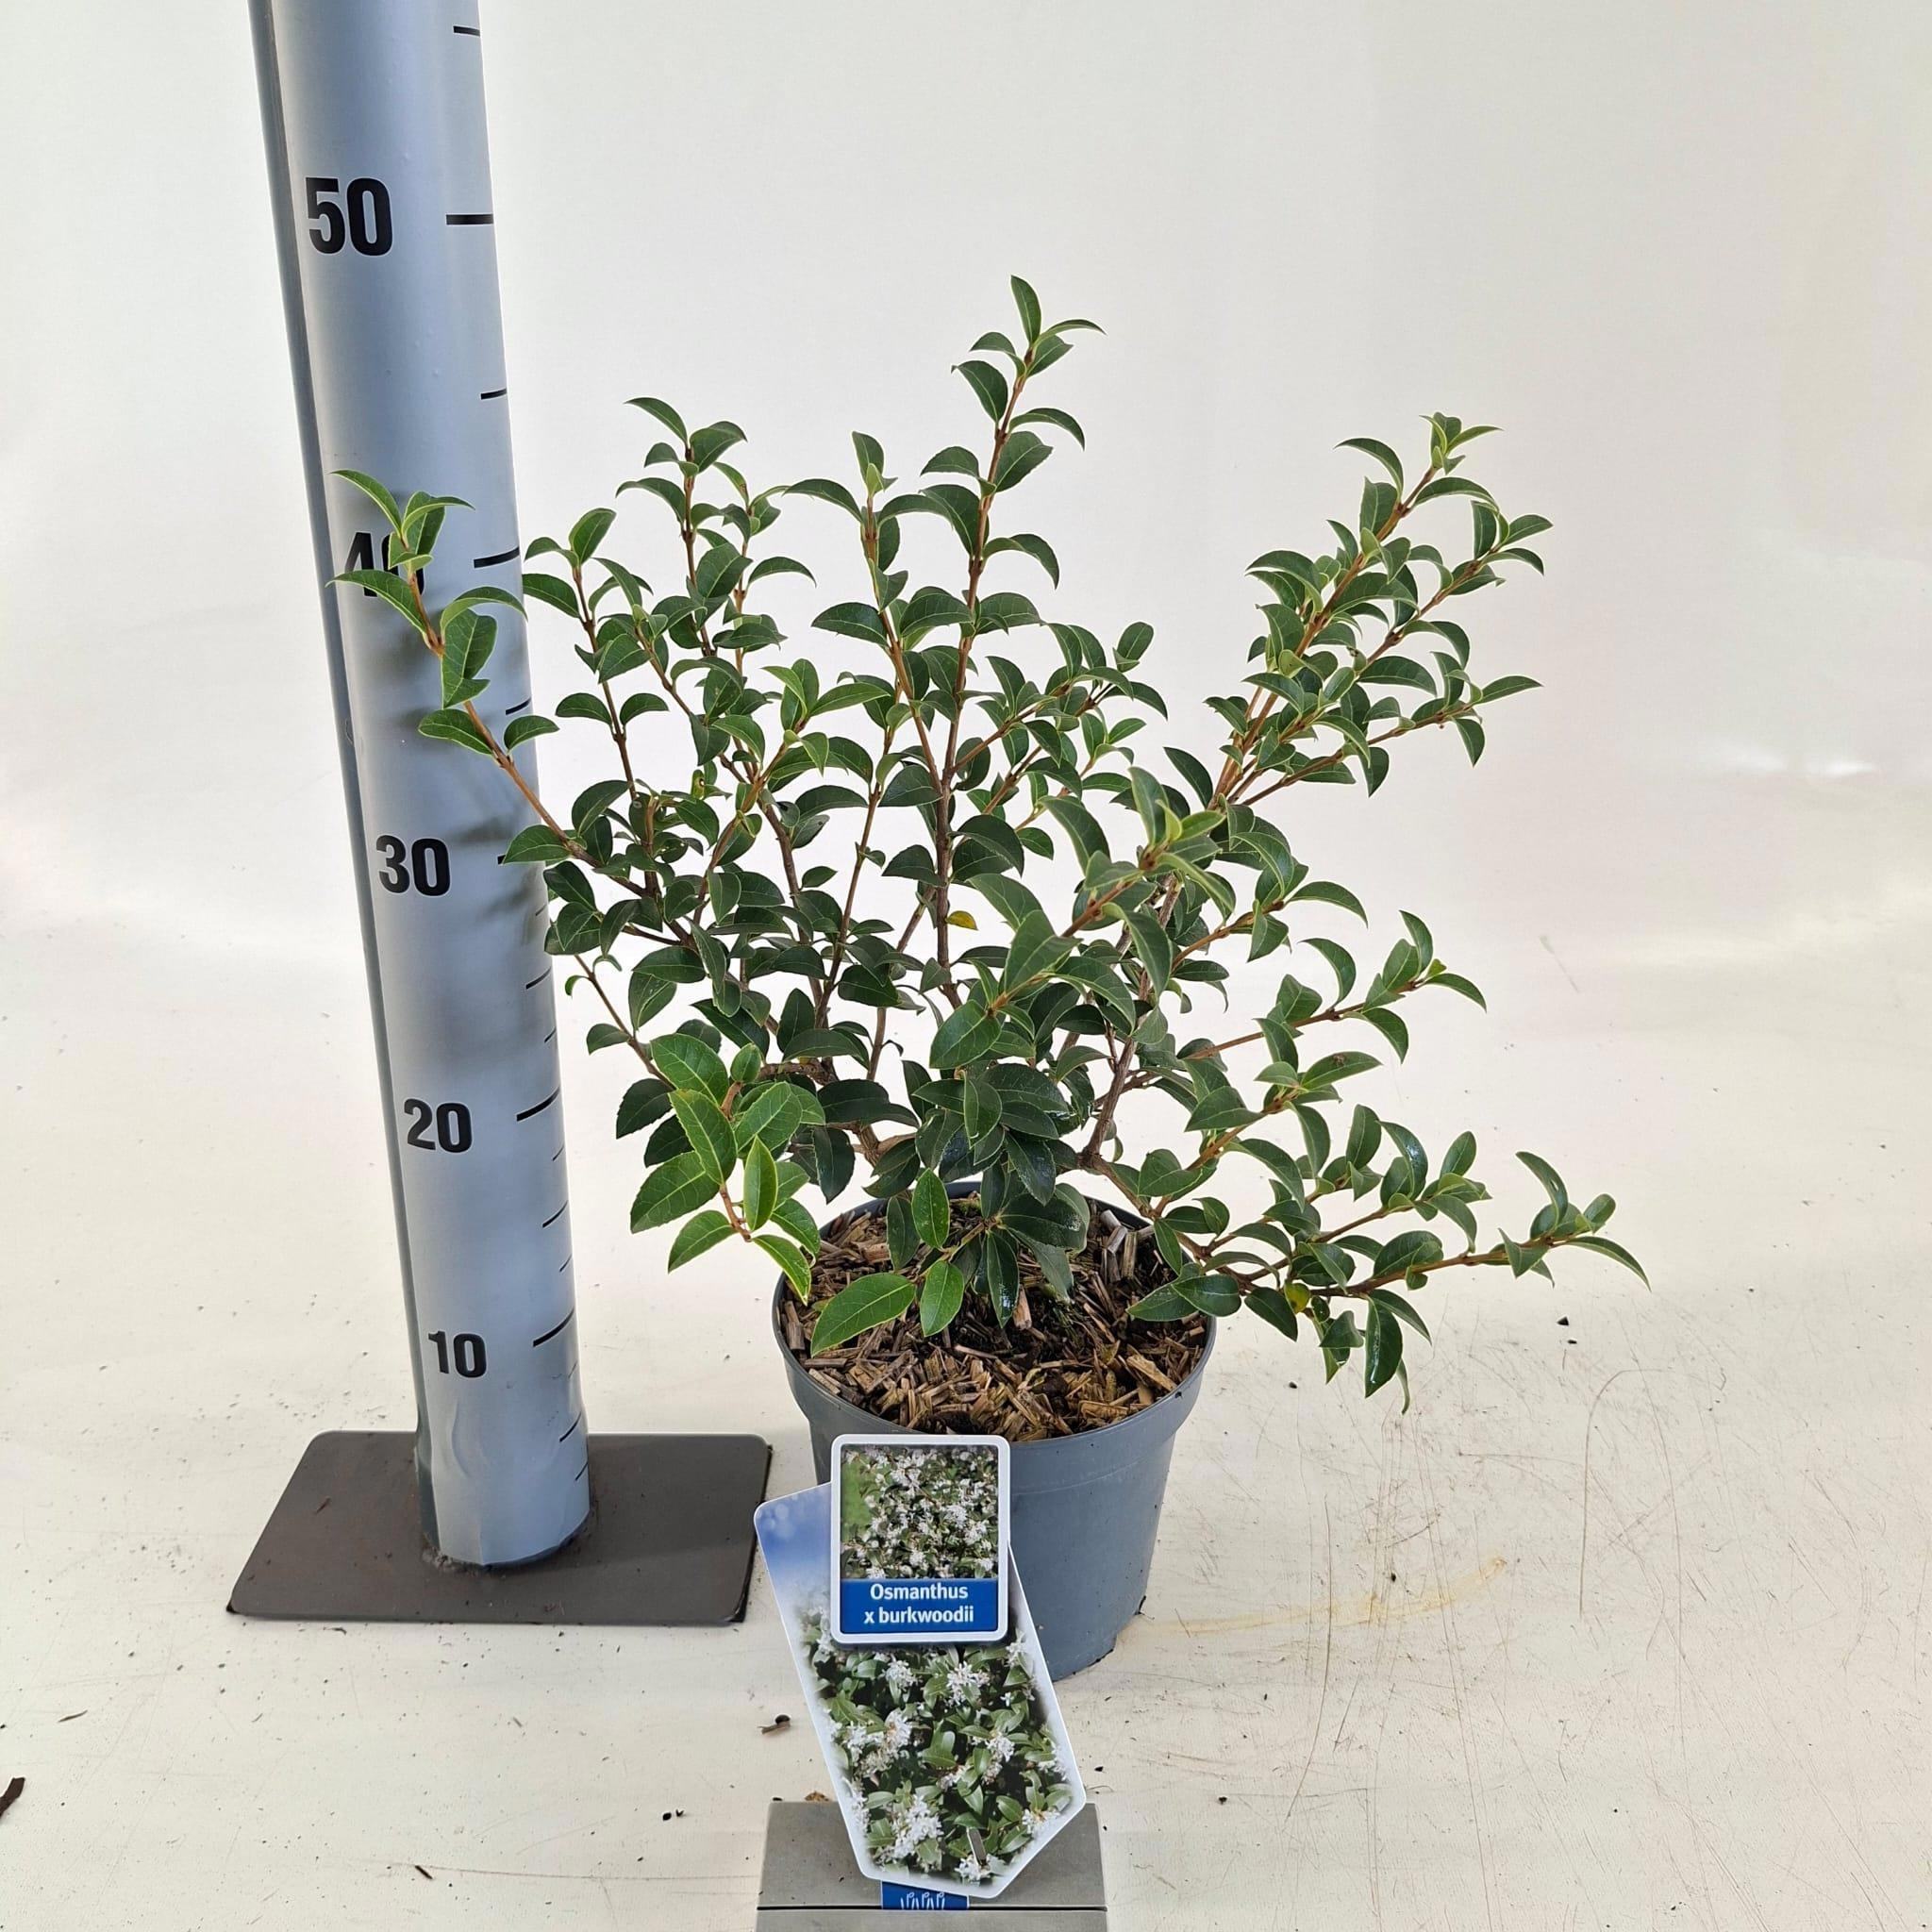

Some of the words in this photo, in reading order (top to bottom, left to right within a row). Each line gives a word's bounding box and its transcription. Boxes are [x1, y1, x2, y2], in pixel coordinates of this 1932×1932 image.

[305, 177, 393, 256] 50
[377, 835, 450, 896] 30
[404, 1099, 472, 1153] 20
[428, 1330, 487, 1378] 10
[864, 1611, 874, 1624] x
[878, 1606, 974, 1624] burkwoodii
[870, 1583, 969, 1600] Osmanthus
